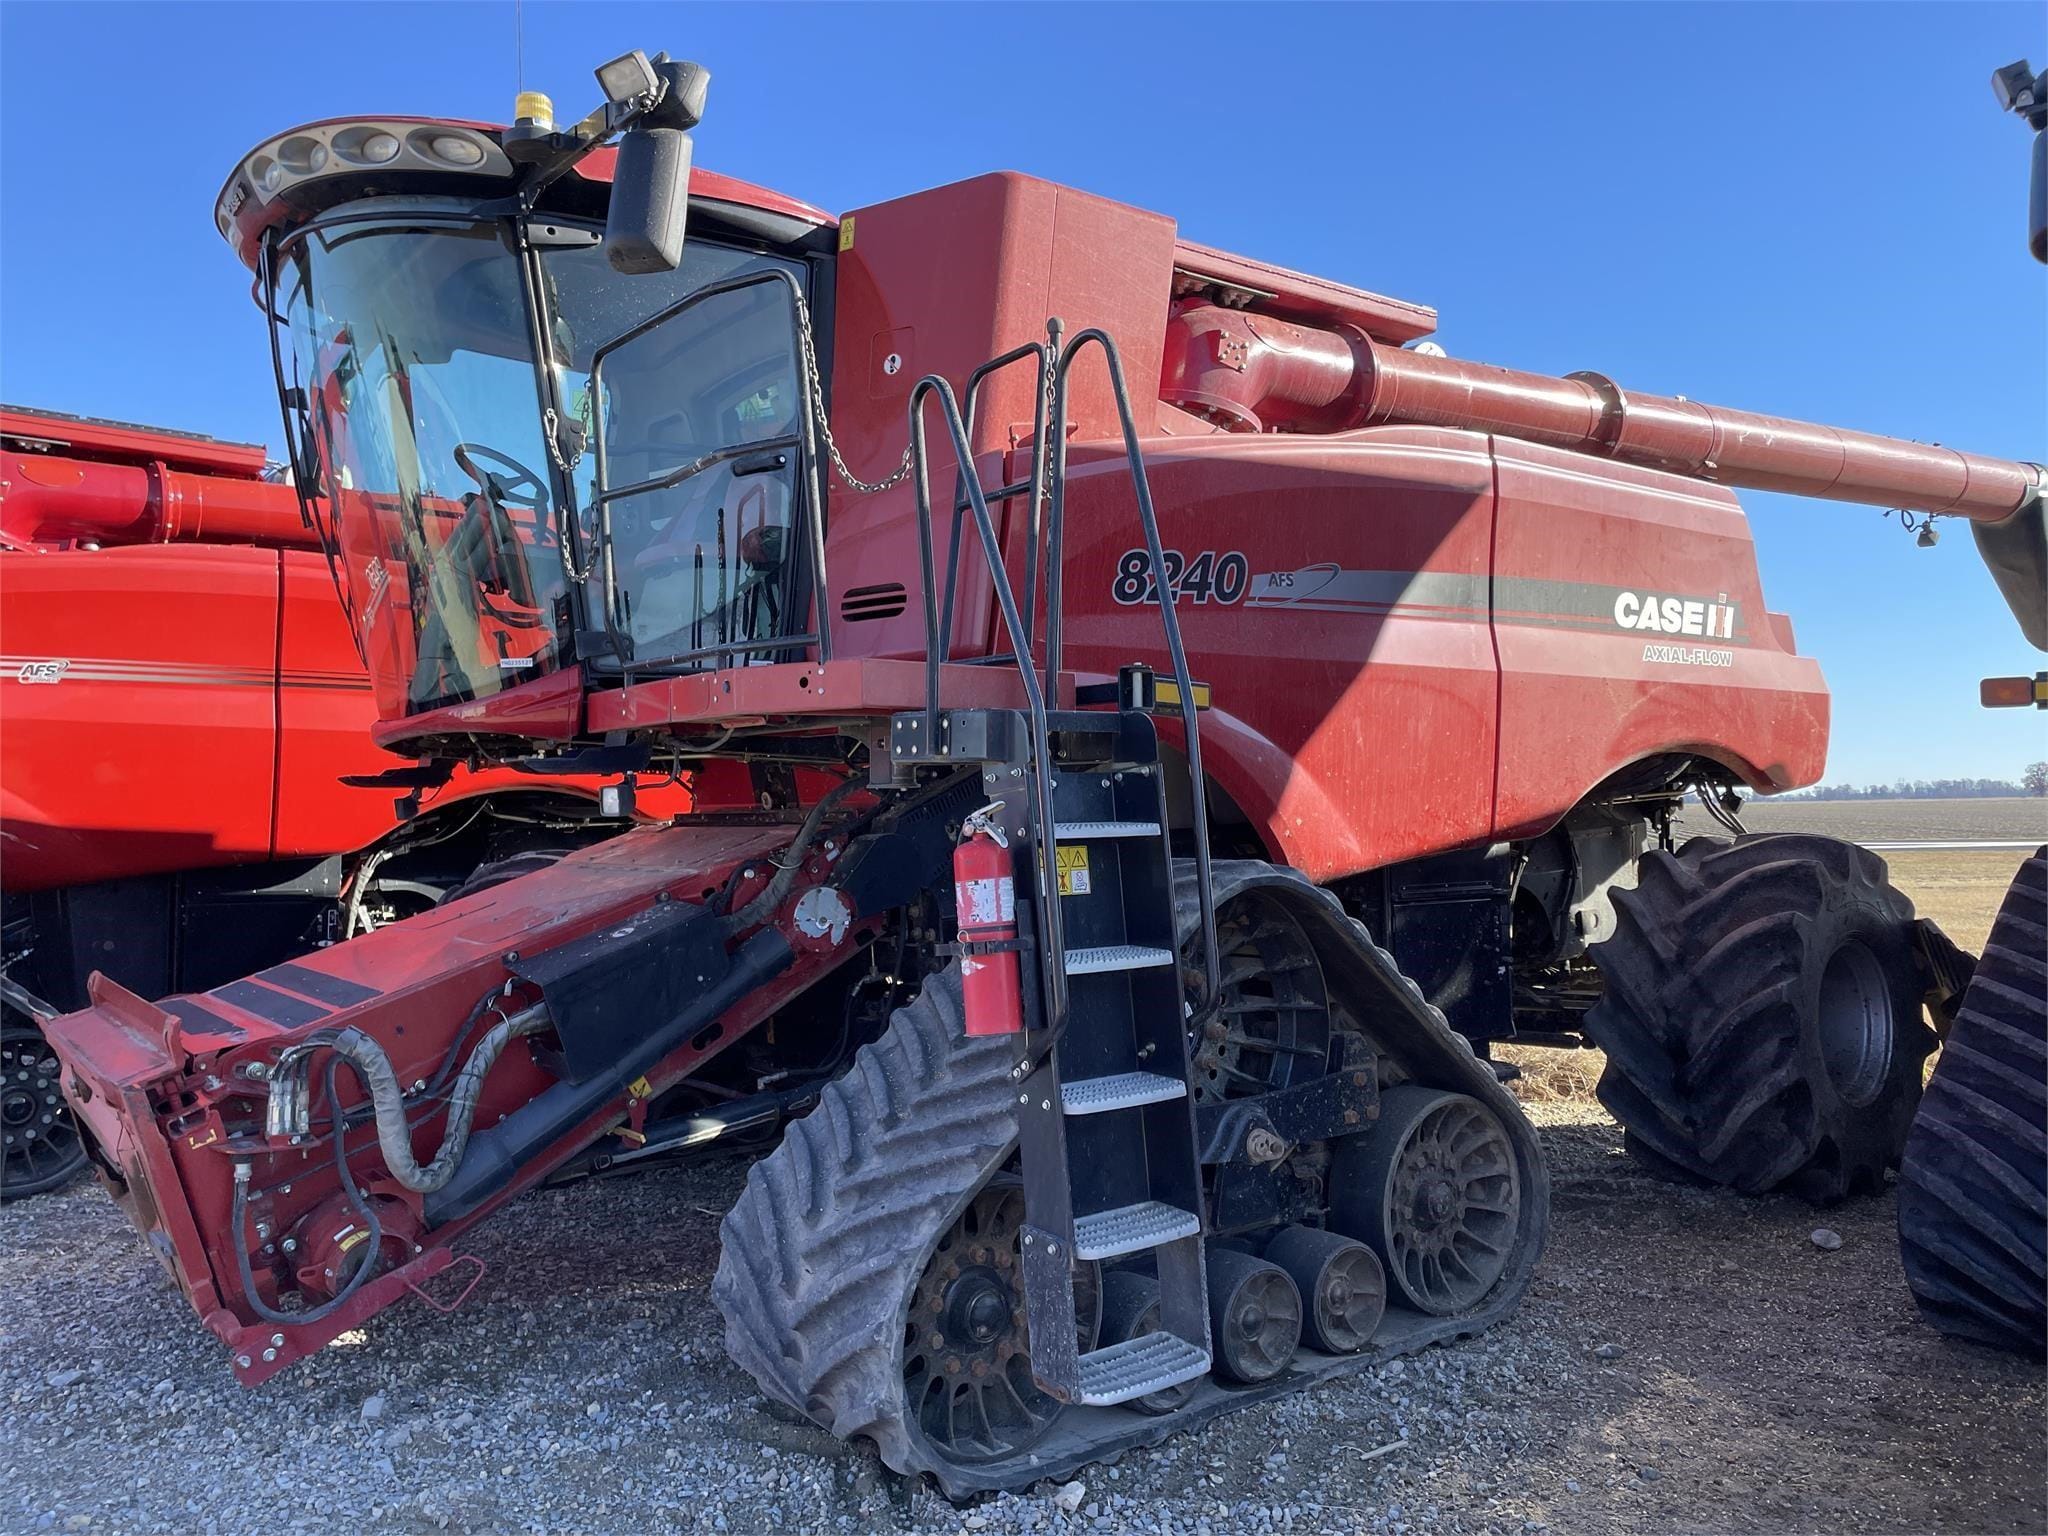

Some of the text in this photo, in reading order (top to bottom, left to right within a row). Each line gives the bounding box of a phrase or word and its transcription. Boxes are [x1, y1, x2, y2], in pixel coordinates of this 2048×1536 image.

[1112, 549, 1248, 605] 8240
[1268, 572, 1294, 588] AFS
[1614, 591, 1705, 635] CASE
[1643, 645, 1732, 667] AXIAL-FLOW
[20, 663, 58, 677] AFS
